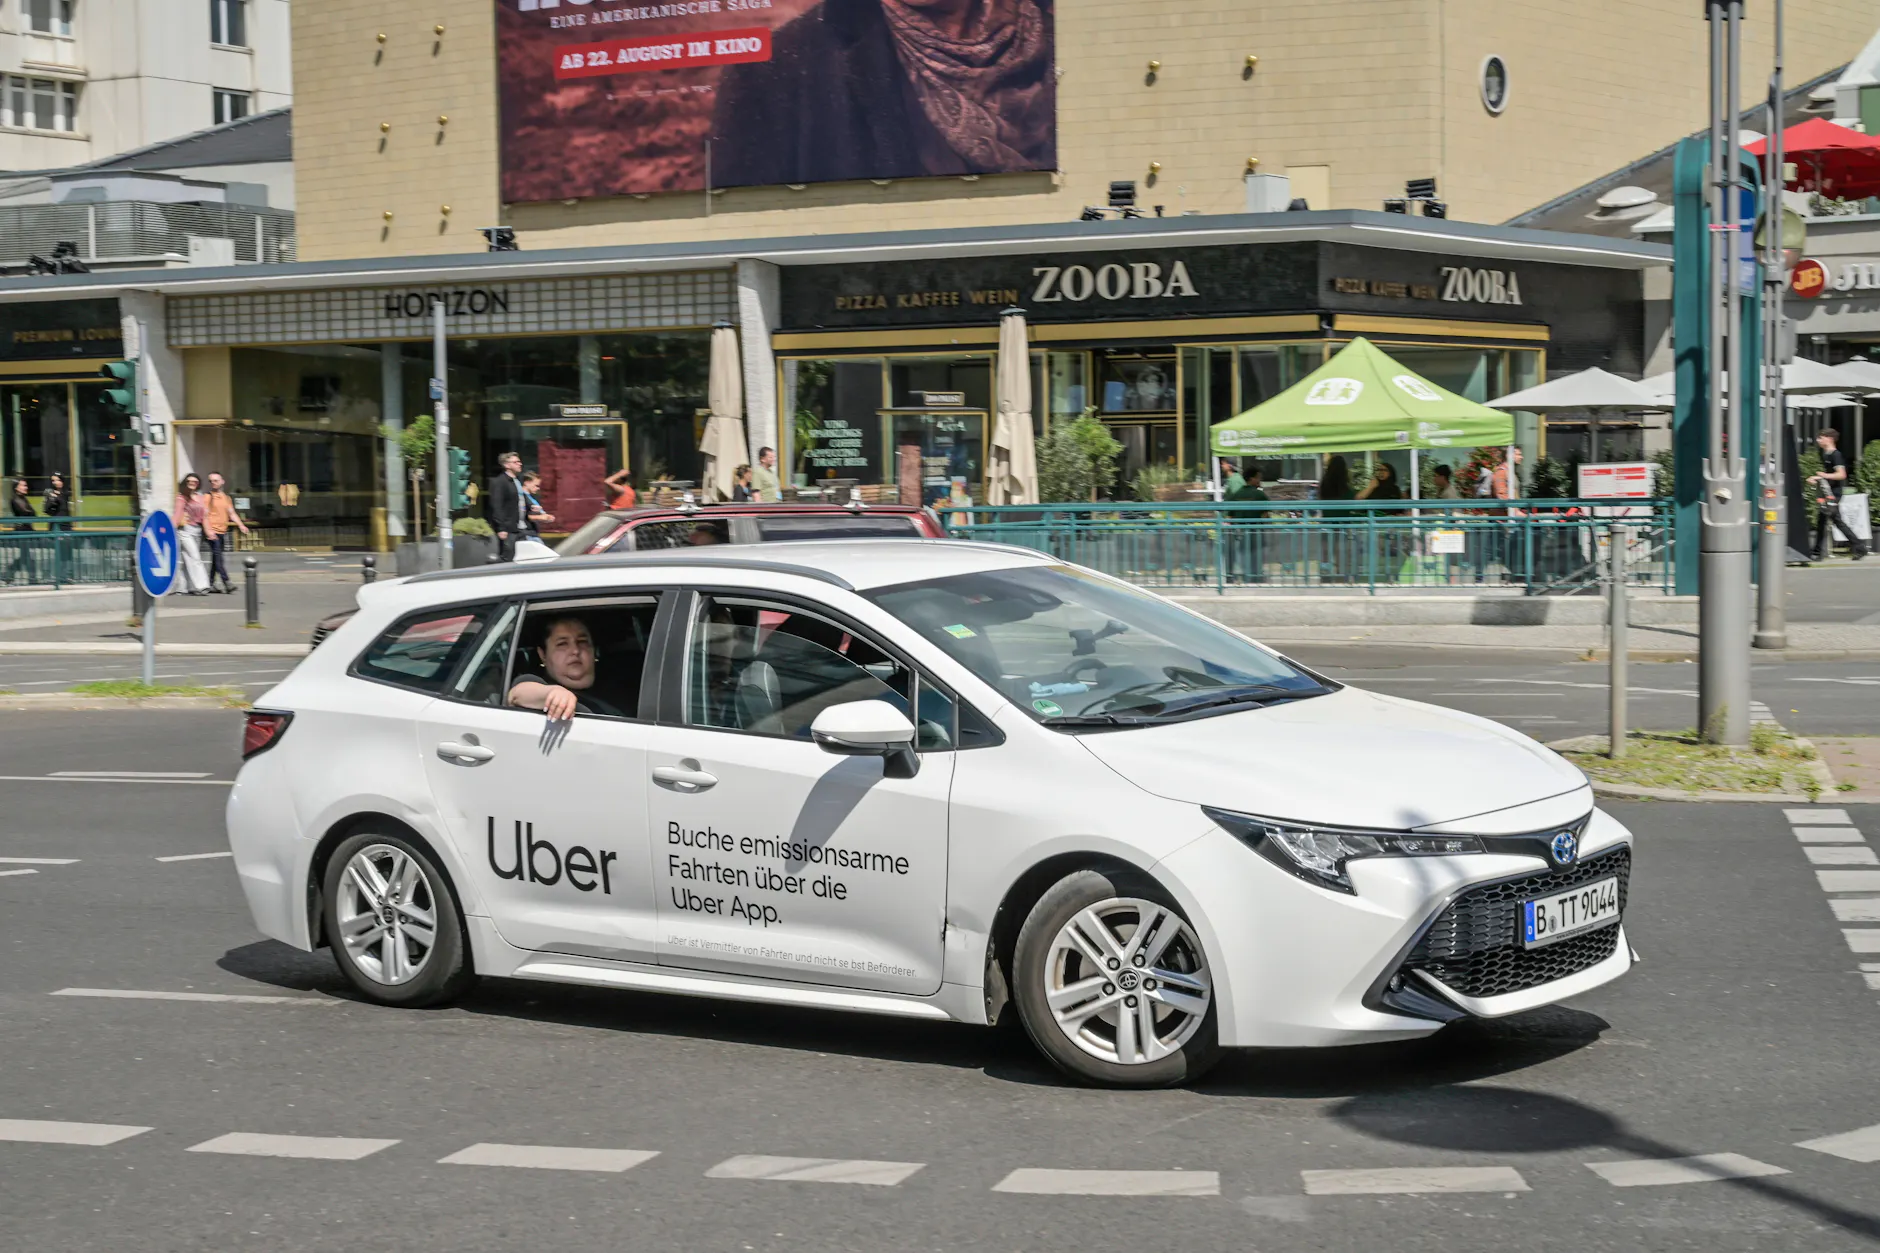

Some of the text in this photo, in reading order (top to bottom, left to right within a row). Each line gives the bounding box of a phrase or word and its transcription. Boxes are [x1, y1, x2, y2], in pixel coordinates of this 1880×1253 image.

[549, 14, 587, 29] EINE
[591, 0, 721, 24] AMERIKANISCHE
[727, 0, 772, 11] SAGA
[560, 36, 762, 69] AB 22. AUGUST IM KINO
[835, 260, 1199, 310] PIZZA KAFFEE WEIN ZOOBA
[1440, 266, 1523, 306] ZOOBA
[1792, 267, 1823, 290] JB
[384, 288, 509, 318] HORIZON
[488, 816, 617, 895] Uber
[668, 821, 909, 875] Buche emissionsarme
[668, 854, 847, 900] Fahrten über die
[671, 886, 782, 928] Uber App.
[1536, 905, 1547, 934] B
[1558, 895, 1578, 928] TT
[1581, 882, 1616, 921] 9044
[667, 934, 687, 946] Uber
[688, 938, 699, 948] ist
[699, 938, 742, 953] Vermittler
[743, 946, 758, 956] von
[760, 946, 793, 961] Fahrten
[795, 953, 813, 963] und
[814, 954, 838, 967] nicht
[867, 961, 917, 978] Beförderer.
